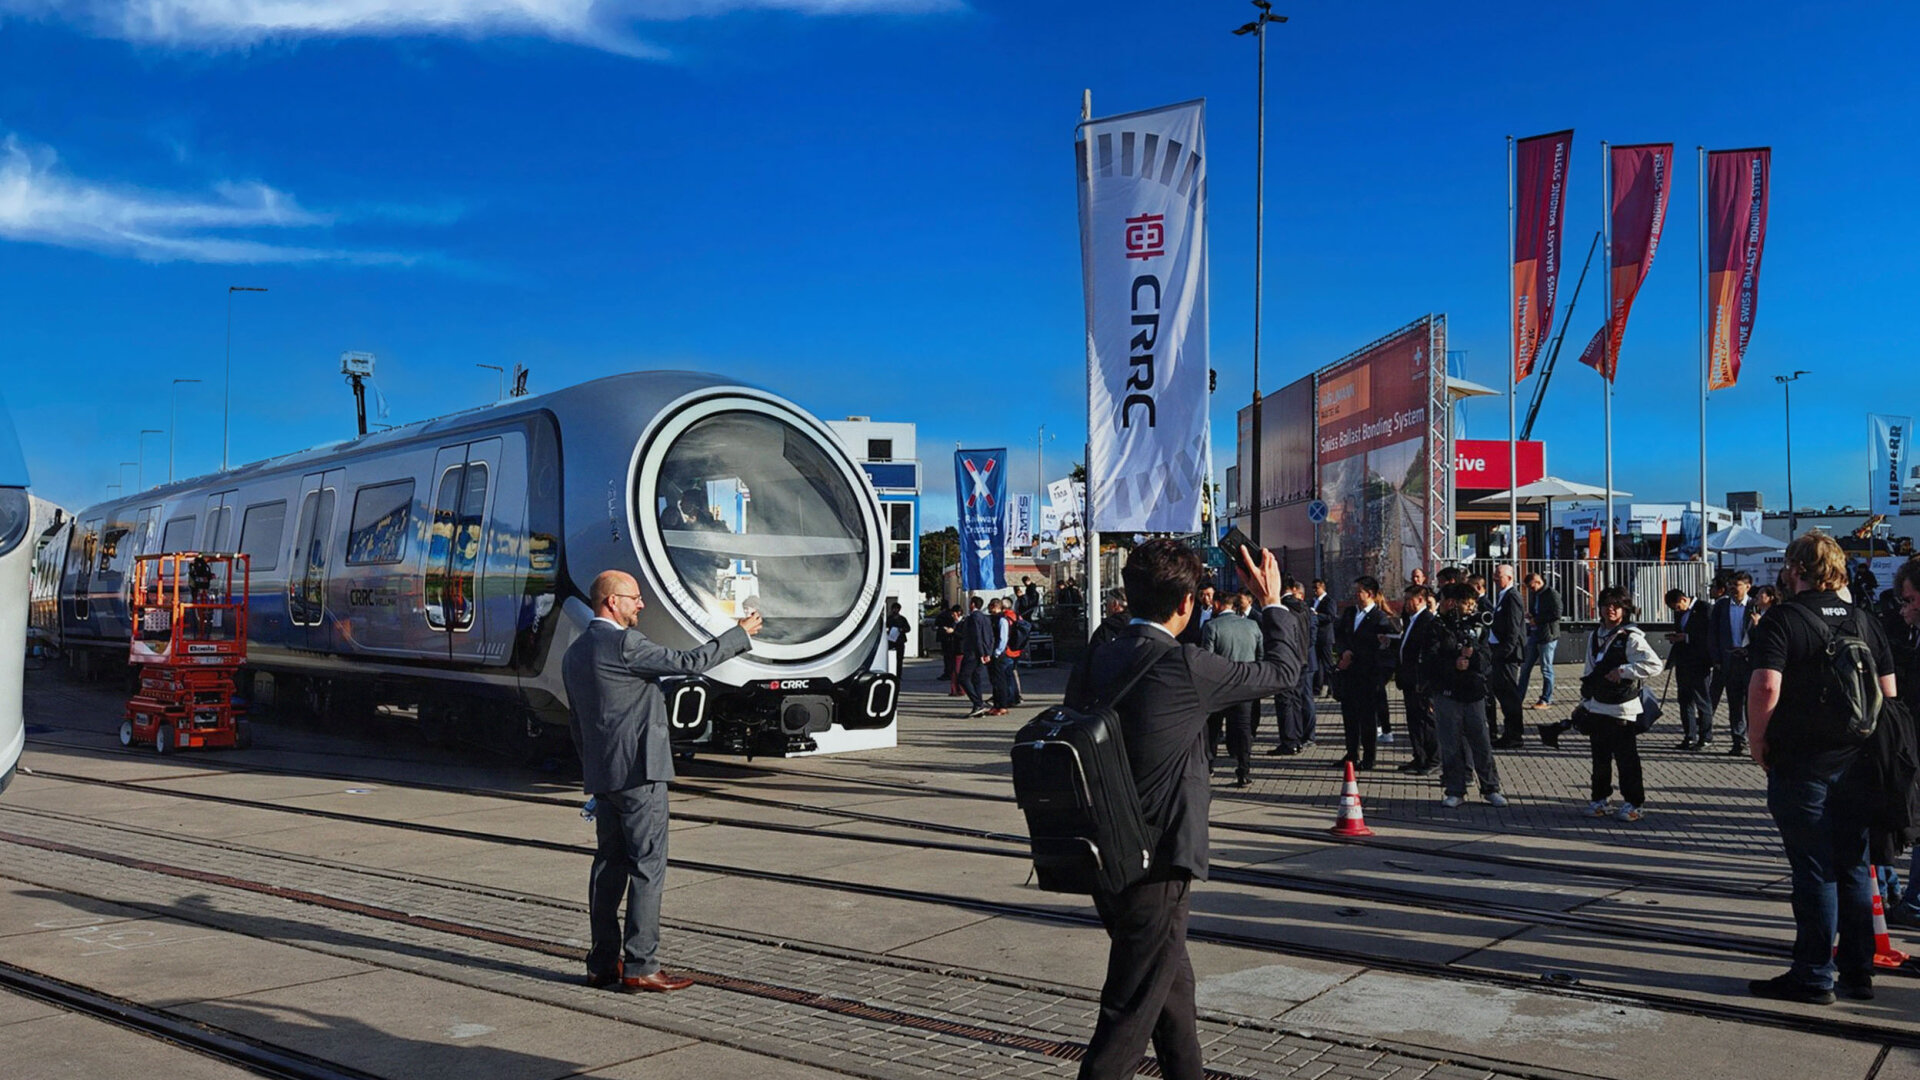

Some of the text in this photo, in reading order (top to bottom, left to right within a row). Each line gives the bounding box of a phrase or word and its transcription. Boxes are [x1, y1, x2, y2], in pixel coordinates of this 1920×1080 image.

[1552, 142, 1564, 182] SYSTEM
[1654, 153, 1664, 191] SYSTEM
[1548, 182, 1561, 227] BONDING
[1651, 191, 1663, 234] BONDING
[1546, 229, 1556, 273] BALLAST
[1738, 159, 1761, 360] ATIVE SWISS BALLAST BONDING SYSTEM
[1122, 274, 1161, 428] CRRC
[1320, 407, 1425, 454] Swiss Ballast Bonding System
[964, 513, 998, 526] Railway
[964, 524, 998, 537] Crossing
[1019, 495, 1028, 532] MTS
[350, 588, 374, 607] CRRC
[780, 679, 810, 690] CRRC
